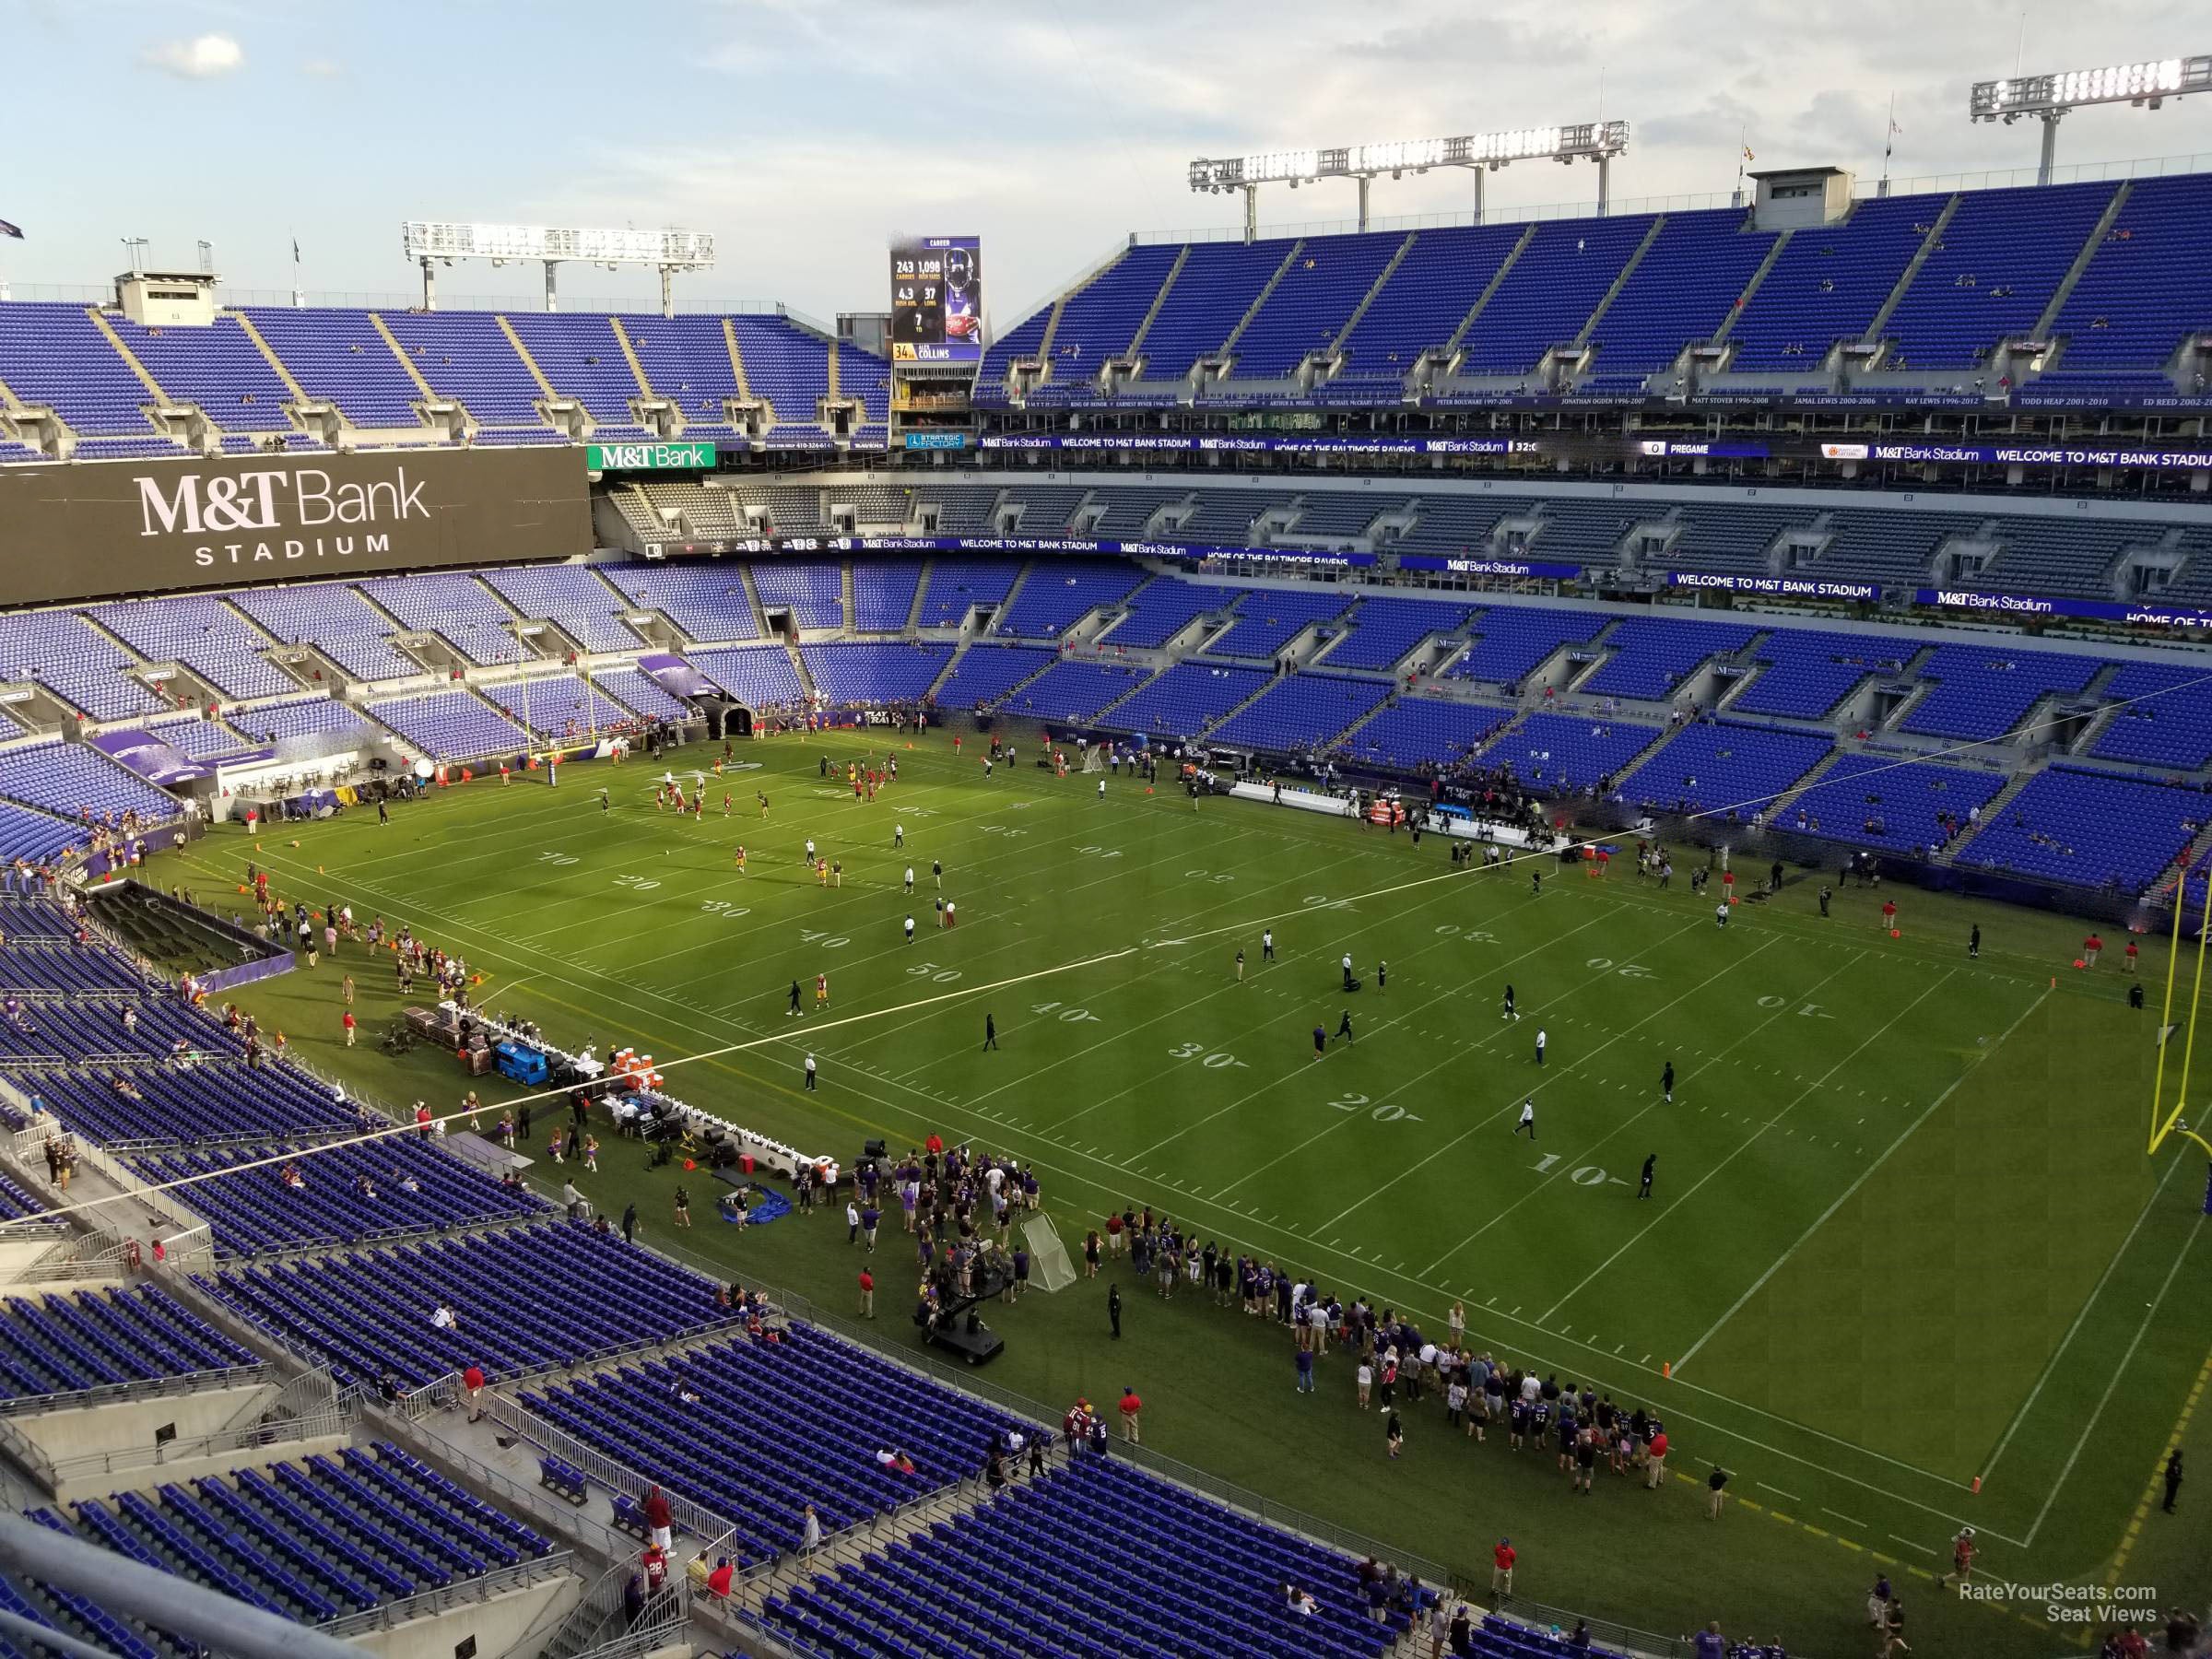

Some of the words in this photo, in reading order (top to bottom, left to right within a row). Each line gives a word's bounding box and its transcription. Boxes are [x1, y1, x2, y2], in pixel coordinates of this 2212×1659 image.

[896, 261, 914, 274] 243
[918, 261, 940, 275] 1,098
[898, 288, 914, 300] 4.3
[924, 288, 936, 300] 37
[915, 313, 923, 325] 7
[896, 345, 908, 359] 34
[918, 349, 950, 359] COLLINS
[2020, 397, 2041, 406] TODD
[982, 438, 1002, 448] M&T
[1001, 438, 1020, 448] Bank
[1020, 439, 1052, 448] Stadium
[1061, 438, 1101, 447] WELCOME
[1102, 439, 1114, 447] TO
[1115, 439, 1134, 447] M&T
[1135, 439, 1157, 447] BANK
[1158, 439, 1191, 448] STADIUM
[1200, 439, 1218, 449] M&T
[1218, 439, 1237, 449] Bank
[1237, 439, 1266, 450] Stadium
[1426, 441, 1448, 452] M&T
[1448, 441, 1469, 452] Bank
[1469, 441, 1503, 453] Stadium
[1670, 444, 1709, 454] PREGAME
[600, 445, 654, 468] M&T
[655, 444, 705, 467] Bank
[1875, 446, 1904, 459] M&T
[1904, 446, 1932, 460] Bank
[1933, 447, 1980, 461] Stadium
[1995, 450, 2063, 463] WELCOME
[2065, 451, 2086, 463] TO
[2088, 452, 2118, 464] M&T
[2120, 453, 2159, 465] BANK
[133, 470, 288, 536] M&T
[295, 465, 431, 525] Bank
[194, 534, 390, 566] STADIUM
[862, 539, 883, 548] M&T
[883, 539, 903, 548] Bank
[903, 539, 935, 549] Stadium
[959, 539, 1003, 548] WELCOME
[1004, 540, 1018, 548] TO
[1018, 540, 1037, 548] M&T
[1039, 540, 1060, 549] BANK
[1062, 541, 1098, 550] STADIUM
[1120, 542, 1139, 553] M&T
[1138, 544, 1157, 554] Bank
[1157, 545, 1186, 555] Stadium
[1447, 559, 1470, 571] M&T
[1469, 560, 1492, 572] Bank
[1492, 562, 1529, 575] Stadium
[1677, 573, 1735, 588] WELCOME
[1736, 577, 1753, 589] TO
[1755, 579, 1782, 591] M&T
[1783, 581, 1816, 594] BANK
[1818, 583, 1872, 597] STADIUM
[1937, 591, 1970, 606] M&T
[1970, 594, 2000, 608] Bank
[2000, 596, 2052, 612] Stadium
[541, 851, 580, 865] 10
[613, 876, 662, 890] 20
[703, 900, 751, 918] 30
[800, 931, 851, 948] 40
[906, 962, 962, 982] 50
[1030, 1001, 1090, 1022] 40
[1168, 1042, 1236, 1068] 30
[1327, 1092, 1406, 1122] 20
[1525, 1152, 1607, 1185] 10
[1535, 1411, 1547, 1423] 52
[649, 1561, 663, 1576] 28
